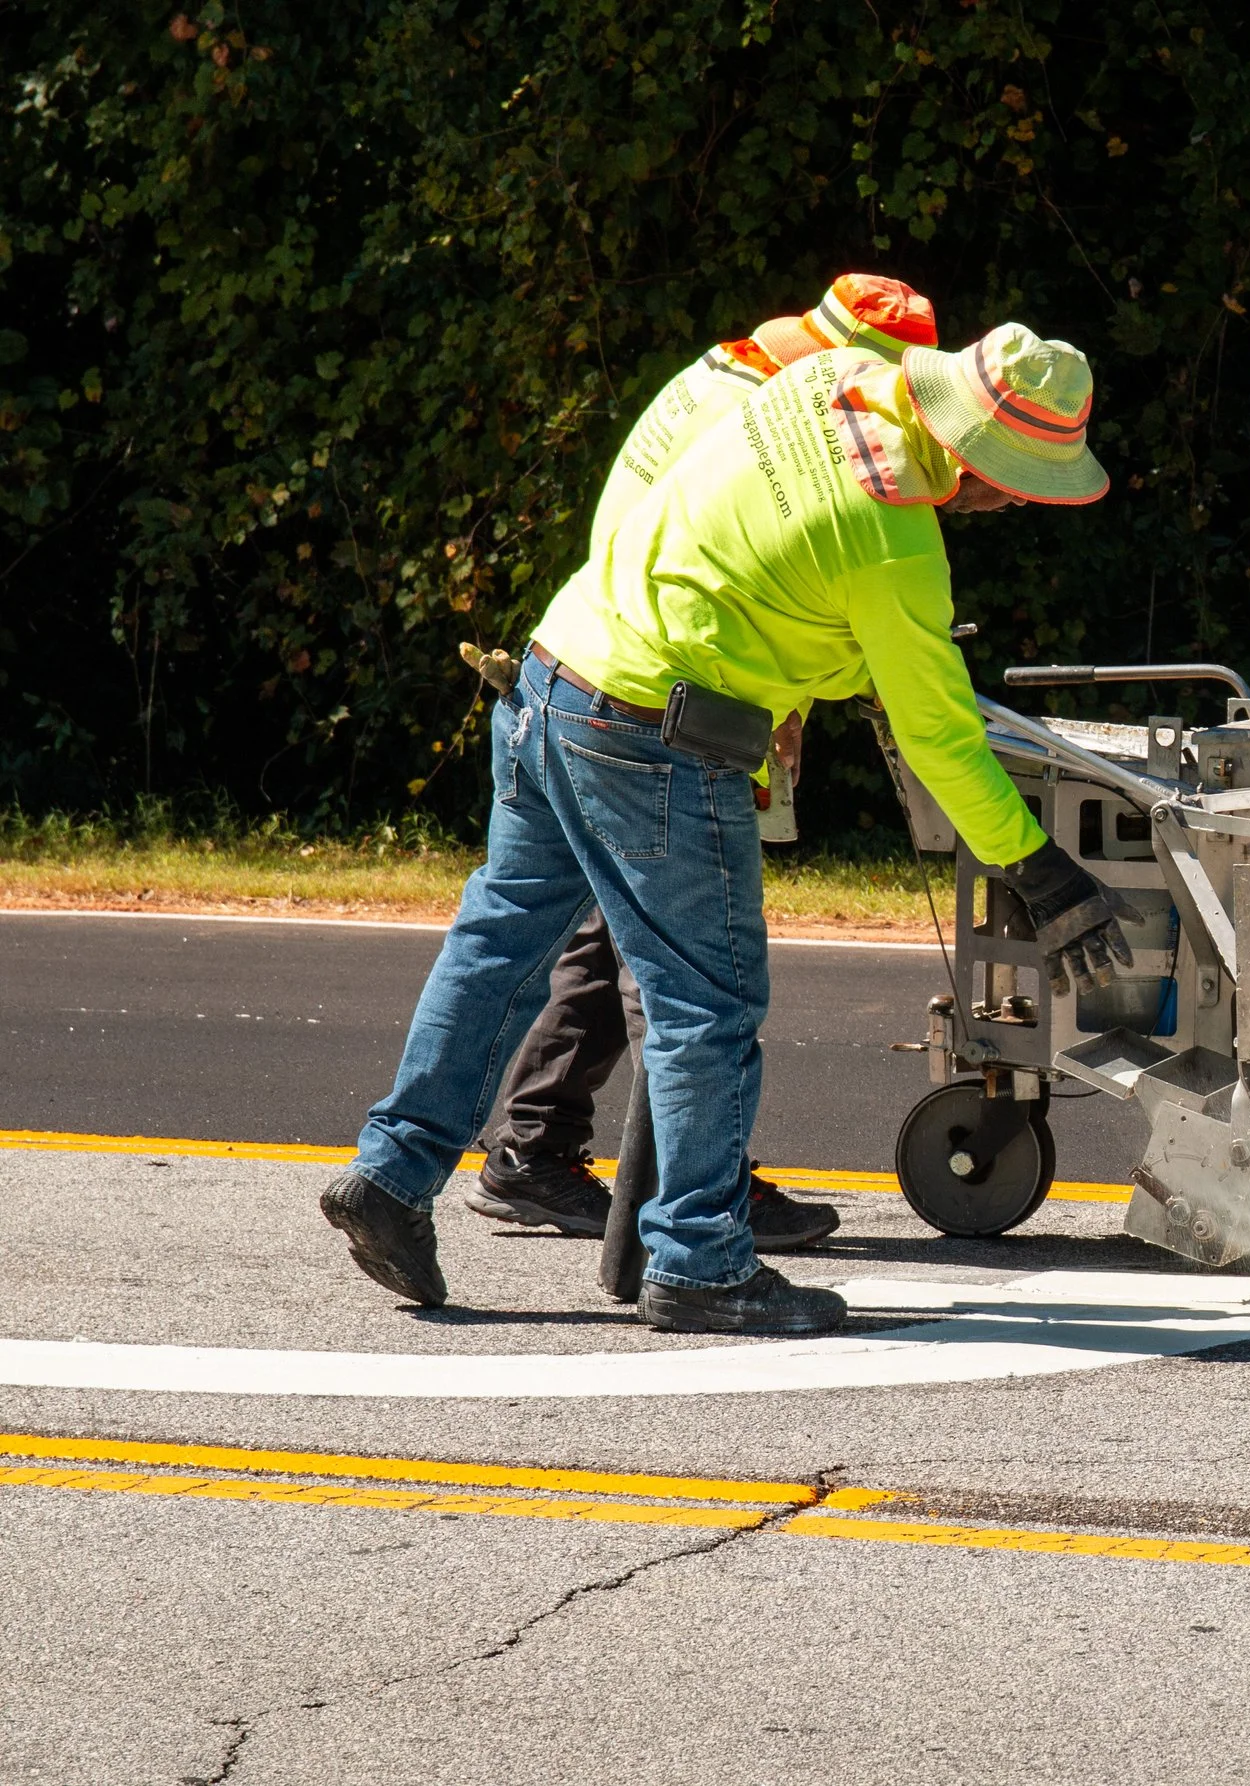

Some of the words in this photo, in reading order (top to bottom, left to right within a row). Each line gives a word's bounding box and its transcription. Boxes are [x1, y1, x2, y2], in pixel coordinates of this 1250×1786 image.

[769, 427, 781, 441] DOT
[776, 442, 787, 462] Signs
[781, 426, 791, 441] Line
[788, 442, 806, 476] Removal
[790, 415, 812, 466] Thermoplastic
[809, 468, 826, 503] Striping
[803, 419, 822, 458] Warehouse
[819, 460, 835, 493] Striping
[811, 392, 829, 416] 985
[823, 429, 846, 466] 0195
